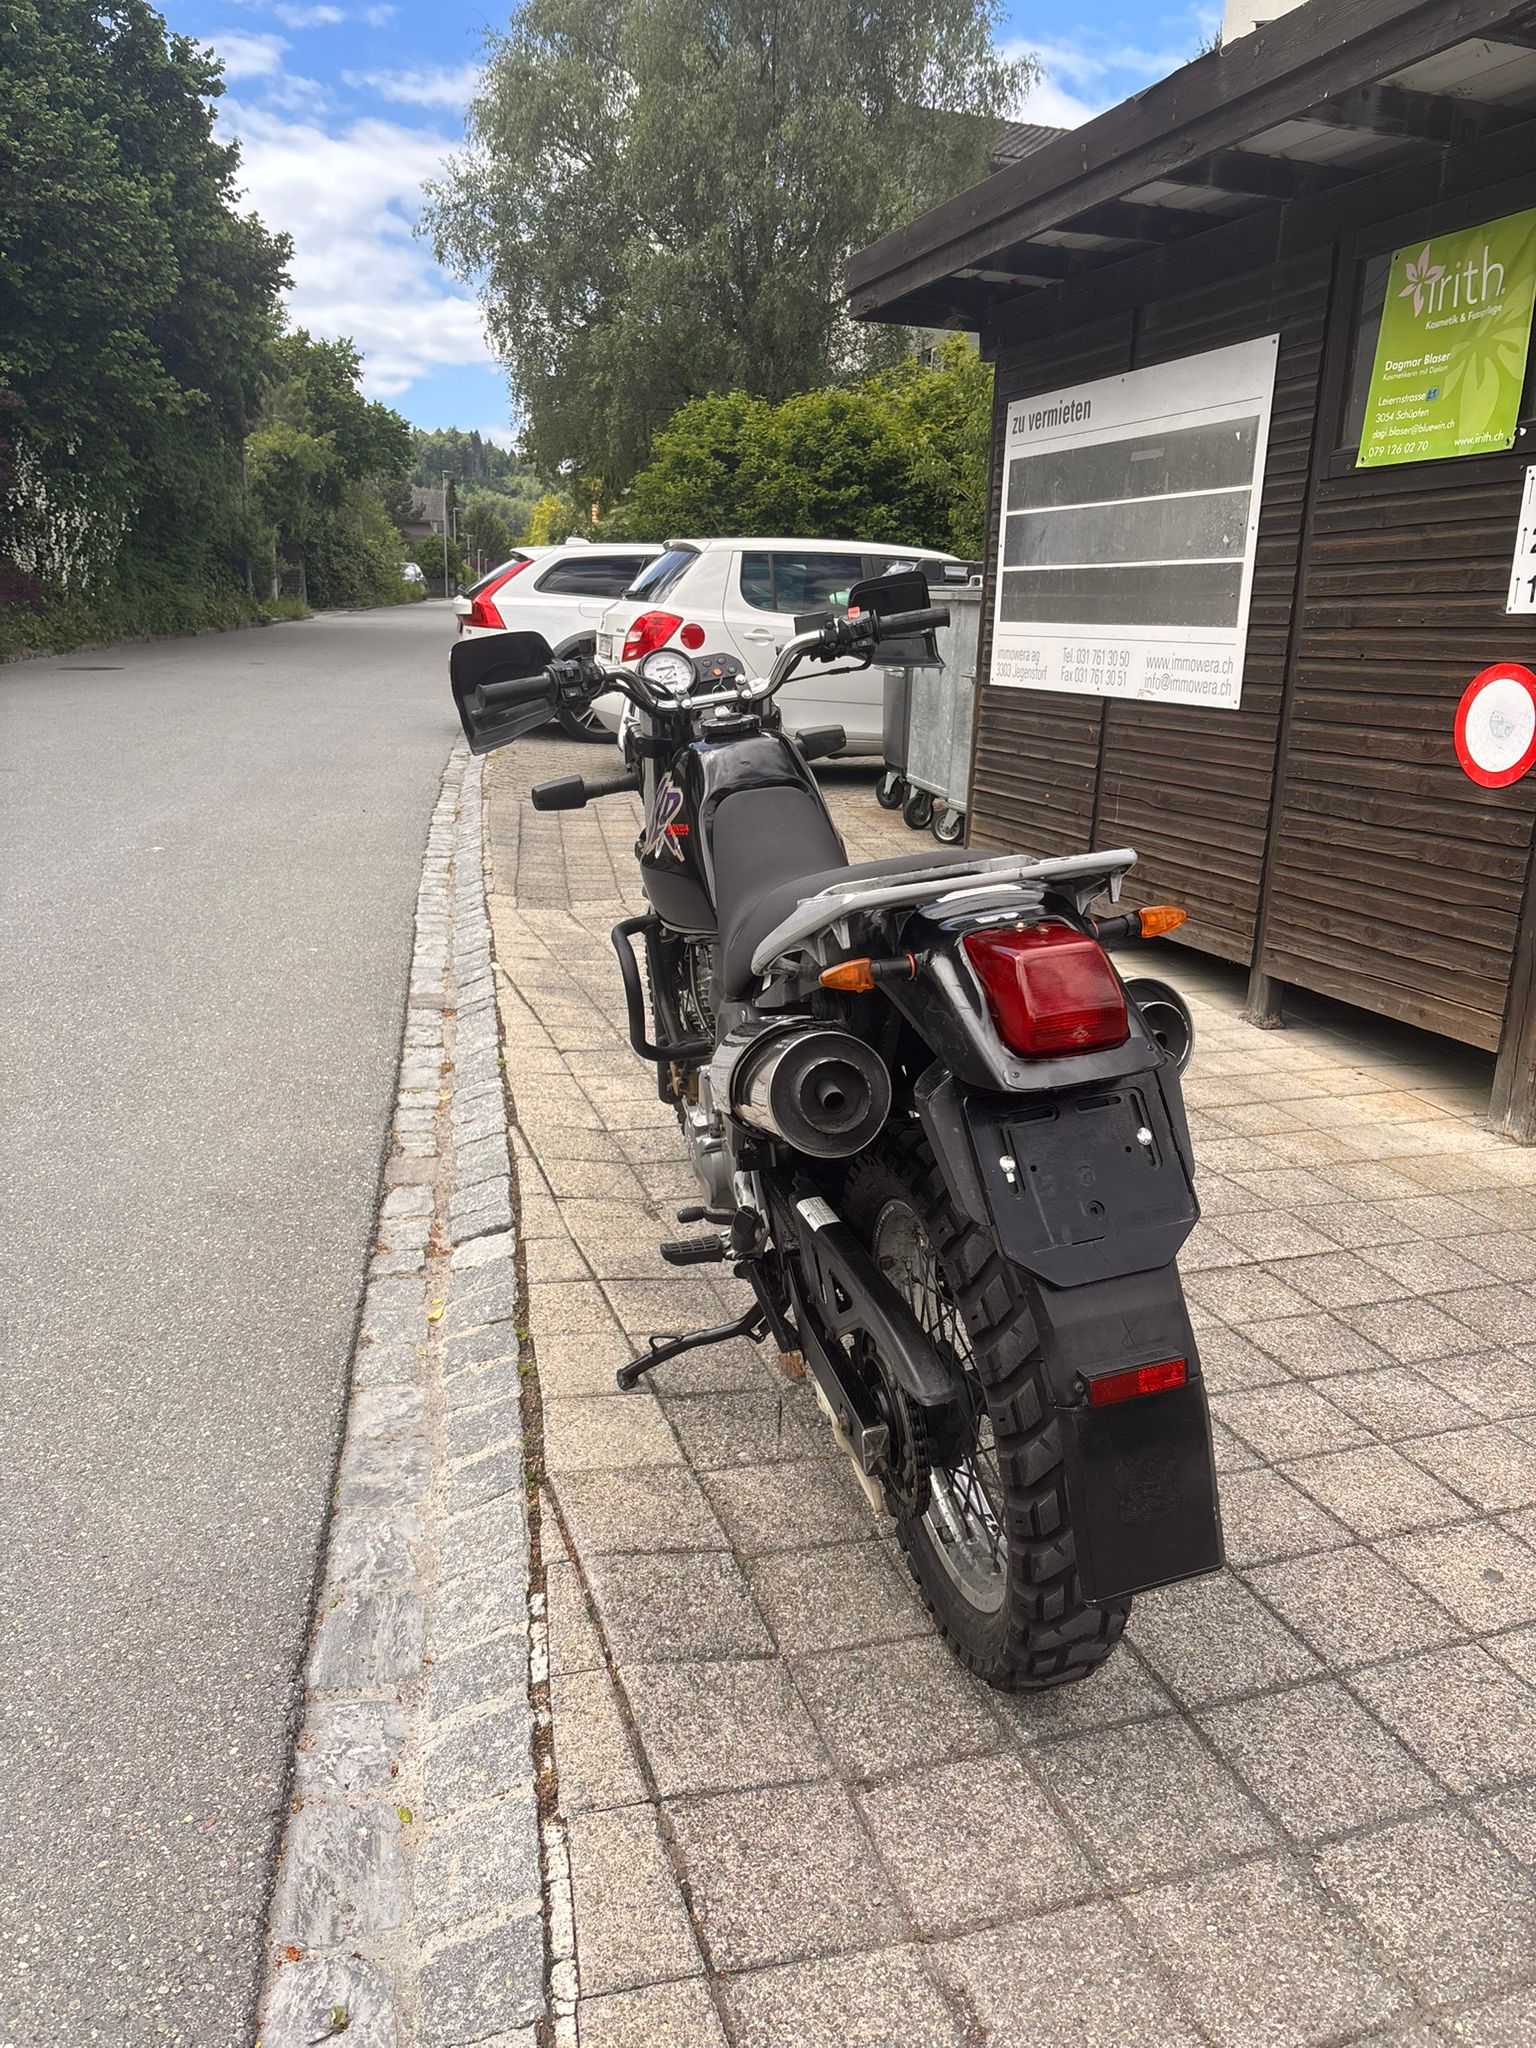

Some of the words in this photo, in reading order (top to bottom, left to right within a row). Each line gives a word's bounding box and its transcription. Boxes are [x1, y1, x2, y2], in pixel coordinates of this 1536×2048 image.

[1425, 314, 1458, 330] Kosmetik
[1459, 312, 1467, 323] &
[1384, 358, 1422, 371] Dagmar
[1424, 352, 1451, 365] Blaser
[1377, 392, 1426, 407] Leiernstrasse
[1012, 415, 1026, 435] zu
[1028, 399, 1091, 432] vermieten
[1375, 412, 1394, 423] 3054
[1396, 407, 1430, 421] Schüpfen
[1372, 419, 1455, 440] dagi.blaser@bluewin.ch
[1454, 430, 1504, 447] www.irith.ch
[1368, 445, 1385, 458] 079
[1387, 443, 1402, 455] 126
[1403, 442, 1415, 453] 02
[1416, 440, 1429, 452] 70
[997, 645, 1031, 661] immowera
[1031, 651, 1040, 665] ag
[1062, 647, 1075, 664] Tel.
[1076, 648, 1090, 664] 031
[1092, 649, 1106, 666] 761
[1107, 650, 1118, 667] 30
[1119, 651, 1130, 667] 50
[1146, 653, 1234, 674] www.immowera.ch
[996, 662, 1012, 678] 3303
[1012, 664, 1048, 682] Jegenstorf
[1060, 666, 1074, 682] Fax
[1074, 667, 1088, 683] 031
[1089, 668, 1104, 684] 761
[1105, 669, 1116, 686] 30
[1117, 670, 1127, 687] 51
[1144, 672, 1232, 696] info@immowera.ch
